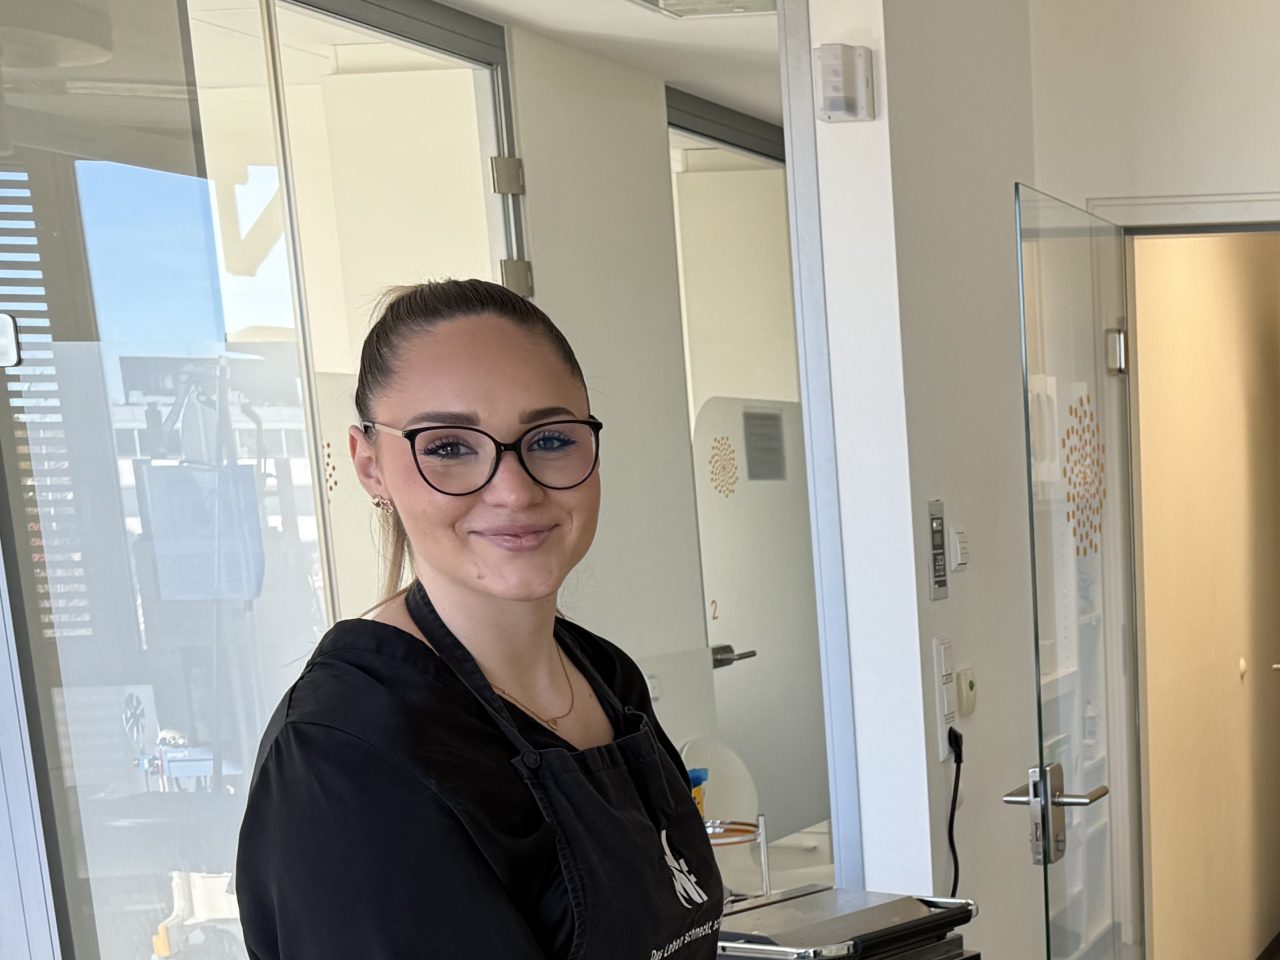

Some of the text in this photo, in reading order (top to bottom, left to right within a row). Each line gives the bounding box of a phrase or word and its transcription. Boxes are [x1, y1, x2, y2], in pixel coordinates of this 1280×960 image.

[709, 599, 719, 620] 2
[664, 936, 684, 957] Leben
[684, 920, 712, 943] schmeckt
